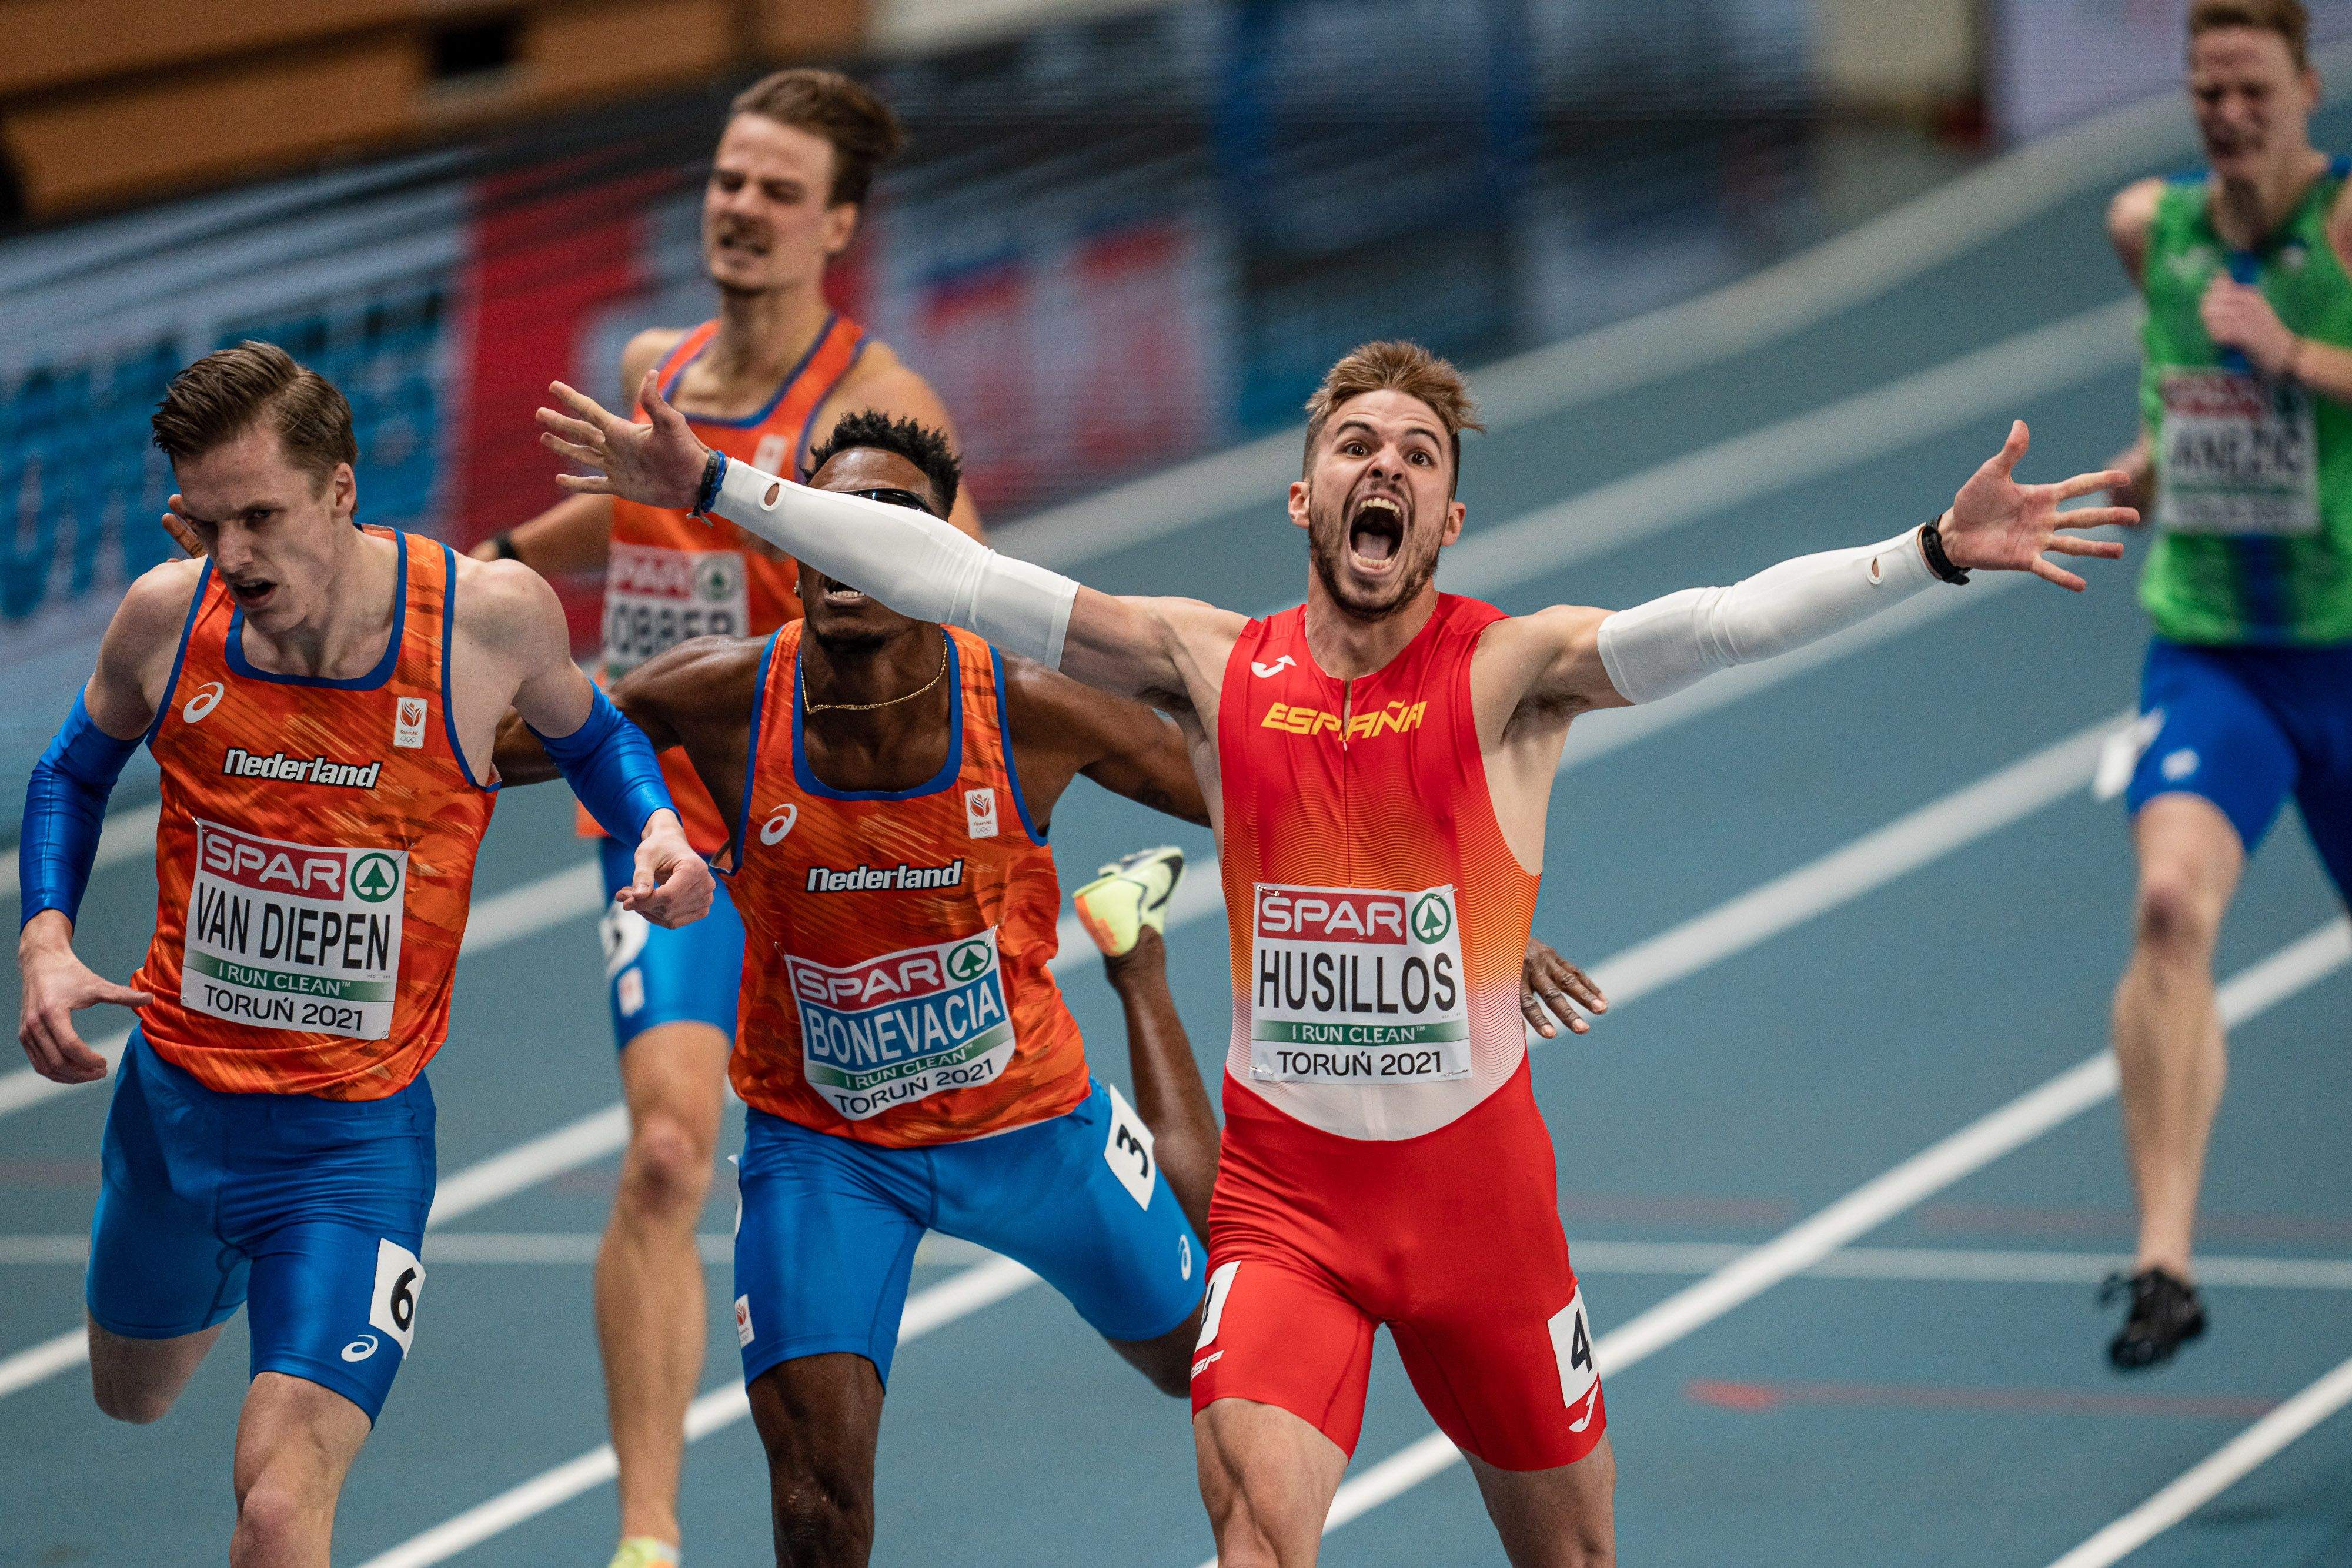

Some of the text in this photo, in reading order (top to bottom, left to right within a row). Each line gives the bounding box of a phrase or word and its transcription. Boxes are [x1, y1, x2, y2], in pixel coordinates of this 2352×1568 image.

[1260, 699, 1428, 741] ESPAÑA
[205, 834, 342, 893] SPAR
[196, 882, 392, 971] VAN DIEPEN
[1261, 897, 1404, 937] SPAR
[219, 962, 223, 977] I
[228, 965, 268, 987] RUN
[797, 958, 940, 1004] SPAR
[1258, 948, 1456, 1015] HUSILLOS
[204, 984, 363, 1031] TORUŃ 2021
[806, 981, 1001, 1065] BONEVACIA
[1292, 1025, 1297, 1039] I
[1302, 1025, 1343, 1042] RUN
[834, 1058, 994, 1115] TORUŃ 2021
[856, 1066, 897, 1089] RUN
[1277, 1051, 1441, 1076] TORUŃ 2021
[1116, 1124, 1150, 1179] 3
[390, 1267, 417, 1332] 6
[1571, 1308, 1593, 1373] 4
